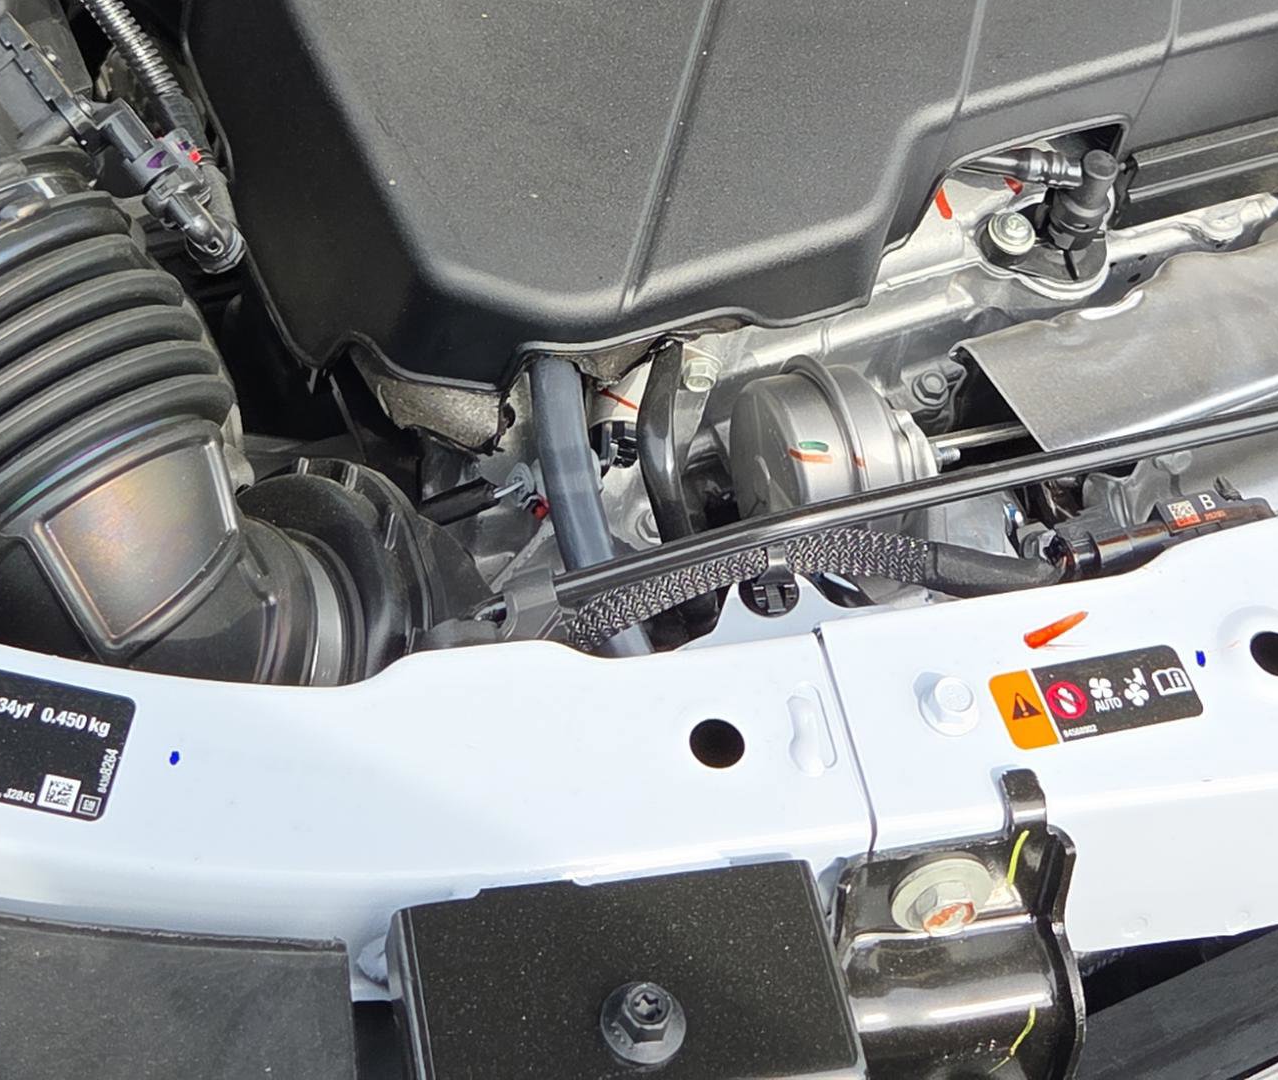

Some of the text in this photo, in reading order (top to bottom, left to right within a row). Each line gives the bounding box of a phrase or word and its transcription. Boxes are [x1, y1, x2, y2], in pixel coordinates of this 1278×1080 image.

[1199, 494, 1216, 510] B
[1095, 697, 1123, 712] AUTO
[40, 706, 88, 730] 0.450
[88, 715, 112, 739] kg
